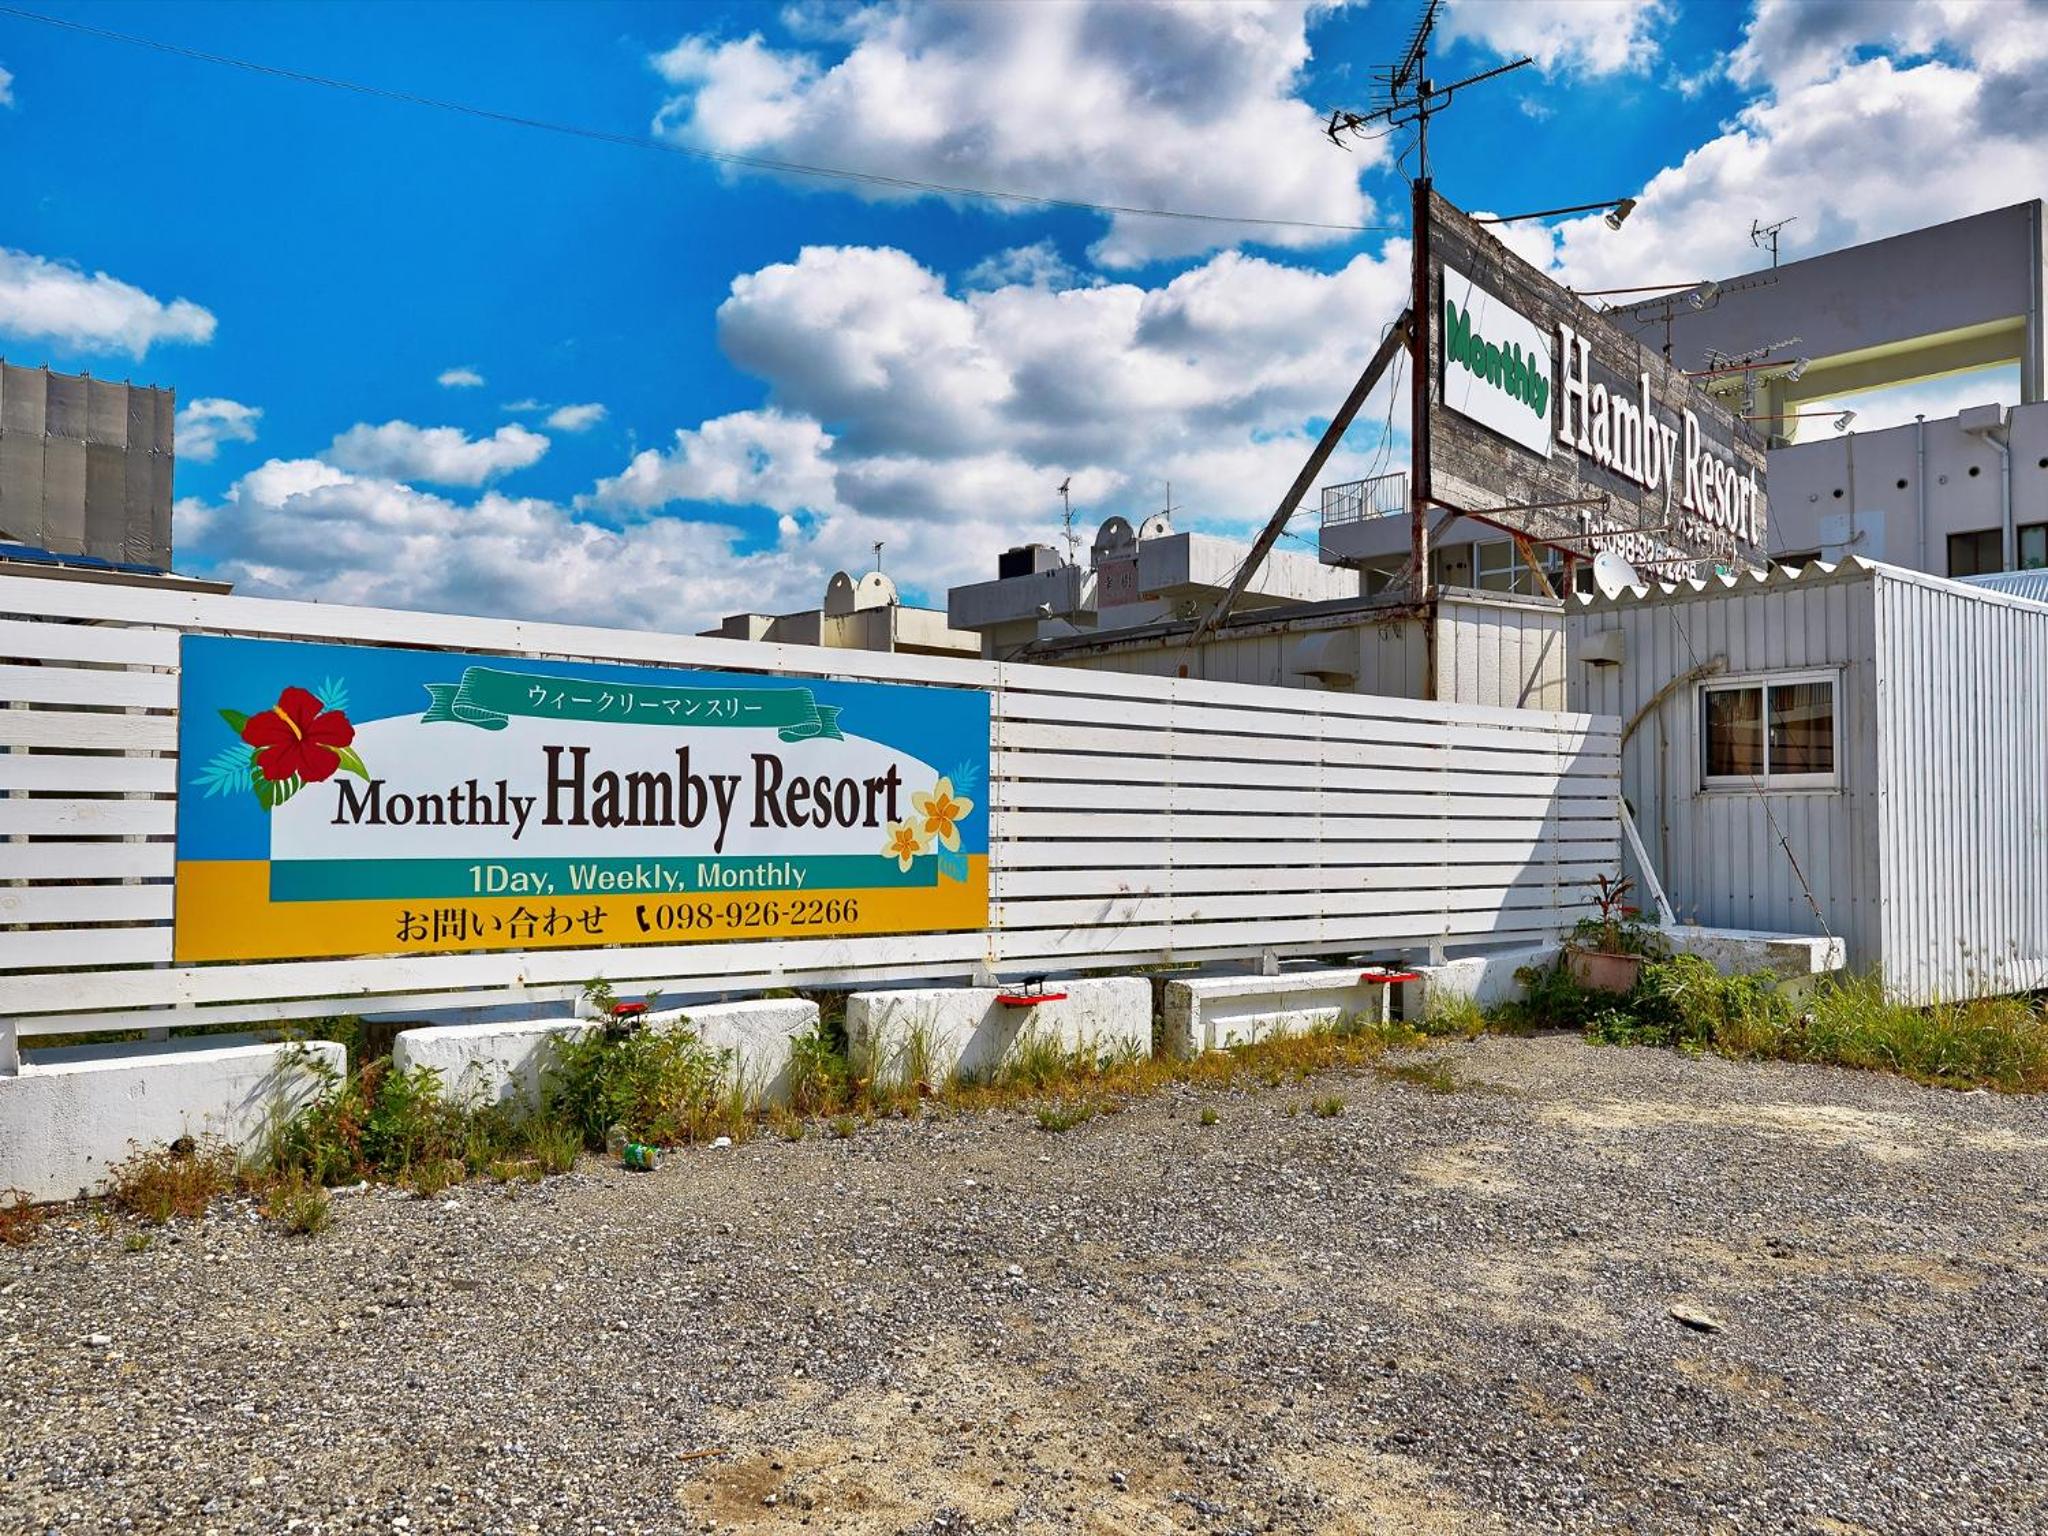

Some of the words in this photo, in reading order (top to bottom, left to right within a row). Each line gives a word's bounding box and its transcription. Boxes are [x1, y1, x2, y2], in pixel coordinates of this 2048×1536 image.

[1446, 299, 1550, 420] Monthly
[1558, 321, 1679, 526] Hamby
[1681, 406, 1759, 546] Resort
[528, 684, 763, 719] ウィークリーマンスリー
[330, 778, 537, 840] Monthly
[541, 745, 742, 854] Hamby
[749, 752, 903, 829] Resort
[468, 864, 555, 895] 1Day,
[568, 863, 685, 893] Weekly,
[696, 862, 807, 888] Monthly
[395, 904, 609, 943] お問い合わせ
[655, 897, 859, 930] 098-926-2266
